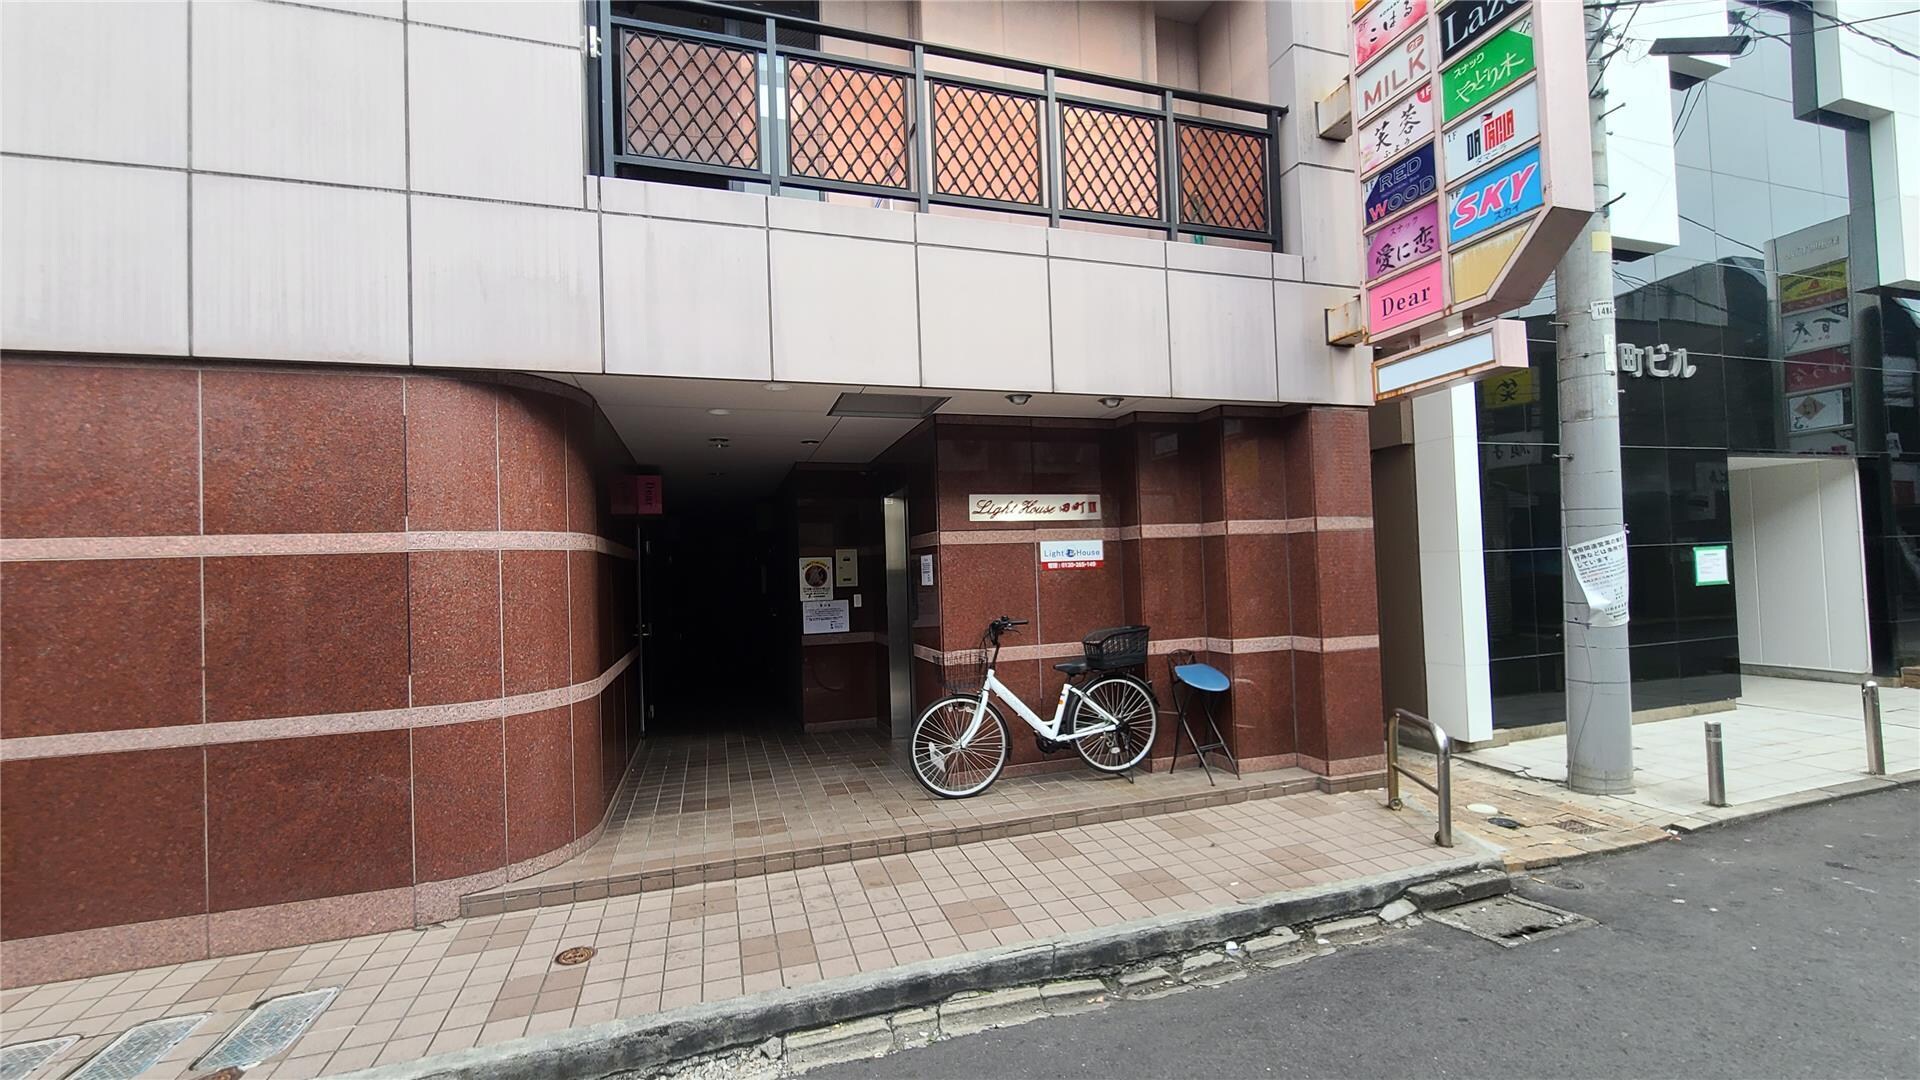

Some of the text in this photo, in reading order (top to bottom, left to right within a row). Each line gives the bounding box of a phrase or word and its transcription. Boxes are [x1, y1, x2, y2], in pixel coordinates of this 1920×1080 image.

[1370, 0, 1413, 43] こはる
[1443, 0, 1518, 52] Laz
[1363, 48, 1427, 112] MILK
[1453, 51, 1485, 79] スナック
[1420, 84, 1433, 100] 1F
[1447, 131, 1457, 143] 1F
[1379, 156, 1422, 193] RED
[1368, 175, 1435, 222] WOOD
[1453, 162, 1539, 229] SKY
[1494, 203, 1519, 221] スカイ
[1375, 225, 1435, 274] 愛に恋
[1382, 286, 1431, 317] Dear
[971, 499, 1018, 519] Light
[1018, 499, 1056, 515] House
[1044, 548, 1101, 558] Light House
